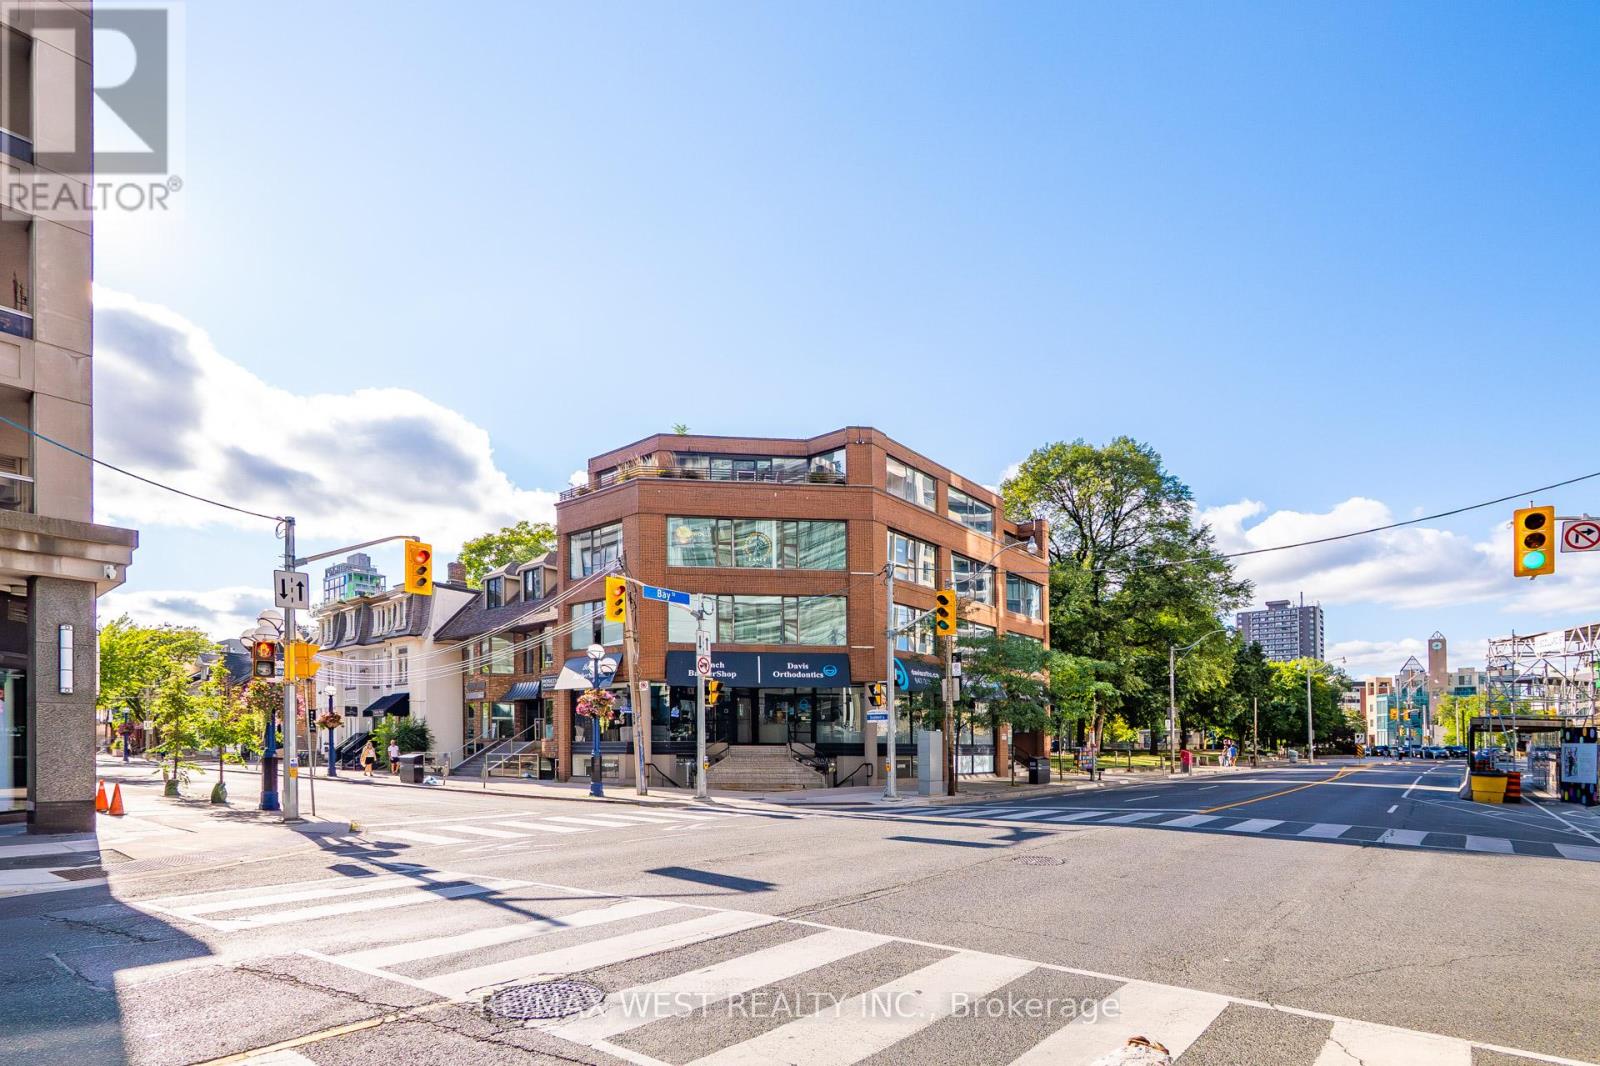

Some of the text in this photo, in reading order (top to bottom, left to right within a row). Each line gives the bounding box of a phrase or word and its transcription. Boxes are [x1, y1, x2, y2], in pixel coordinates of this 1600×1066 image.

[656, 589, 671, 601] Bay
[688, 669, 737, 679] BarShop
[772, 670, 824, 678] Orthodontics
